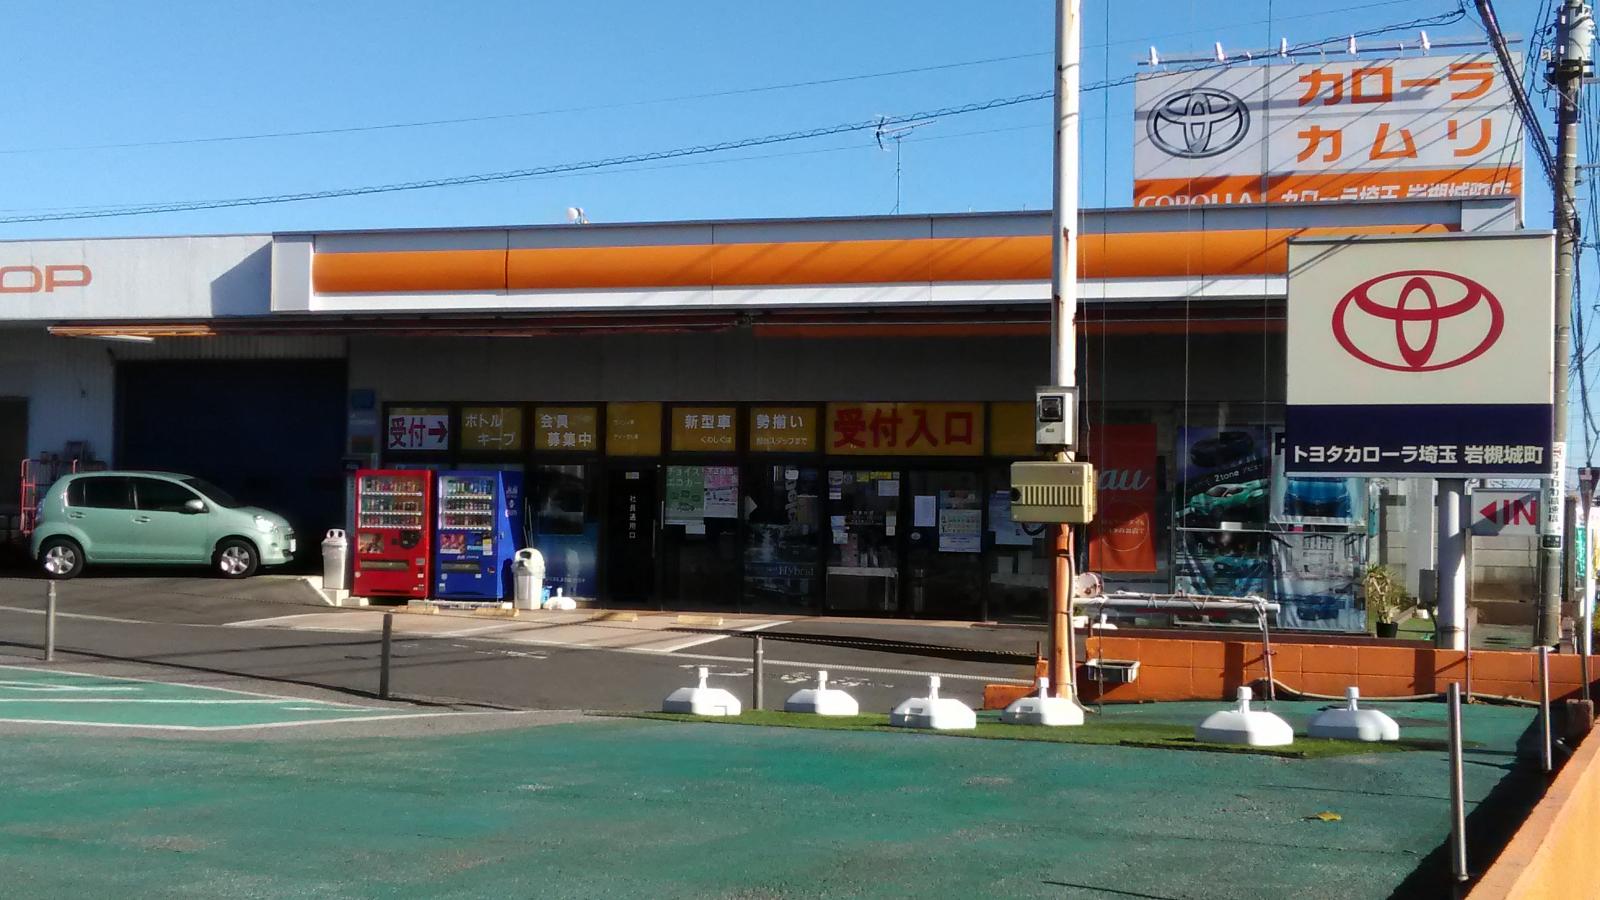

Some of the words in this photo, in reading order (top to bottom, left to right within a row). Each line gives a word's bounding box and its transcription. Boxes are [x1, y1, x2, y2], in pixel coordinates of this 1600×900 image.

[1298, 62, 1495, 107] カローラ
[1297, 118, 1492, 164] カムリ
[389, 416, 427, 449] 受付
[540, 414, 569, 429] 会員
[684, 414, 732, 430] 新型車
[756, 413, 804, 430] 勢揃い
[833, 408, 974, 450] 受付入口
[478, 431, 516, 448] キープ
[547, 431, 593, 448] 募集中
[1294, 444, 1459, 465] トヨタカローラ埼玉
[1464, 444, 1544, 466] 岩槻城町
[1097, 469, 1153, 491] au
[1213, 469, 1241, 482] 2tone
[1503, 498, 1538, 526] IN
